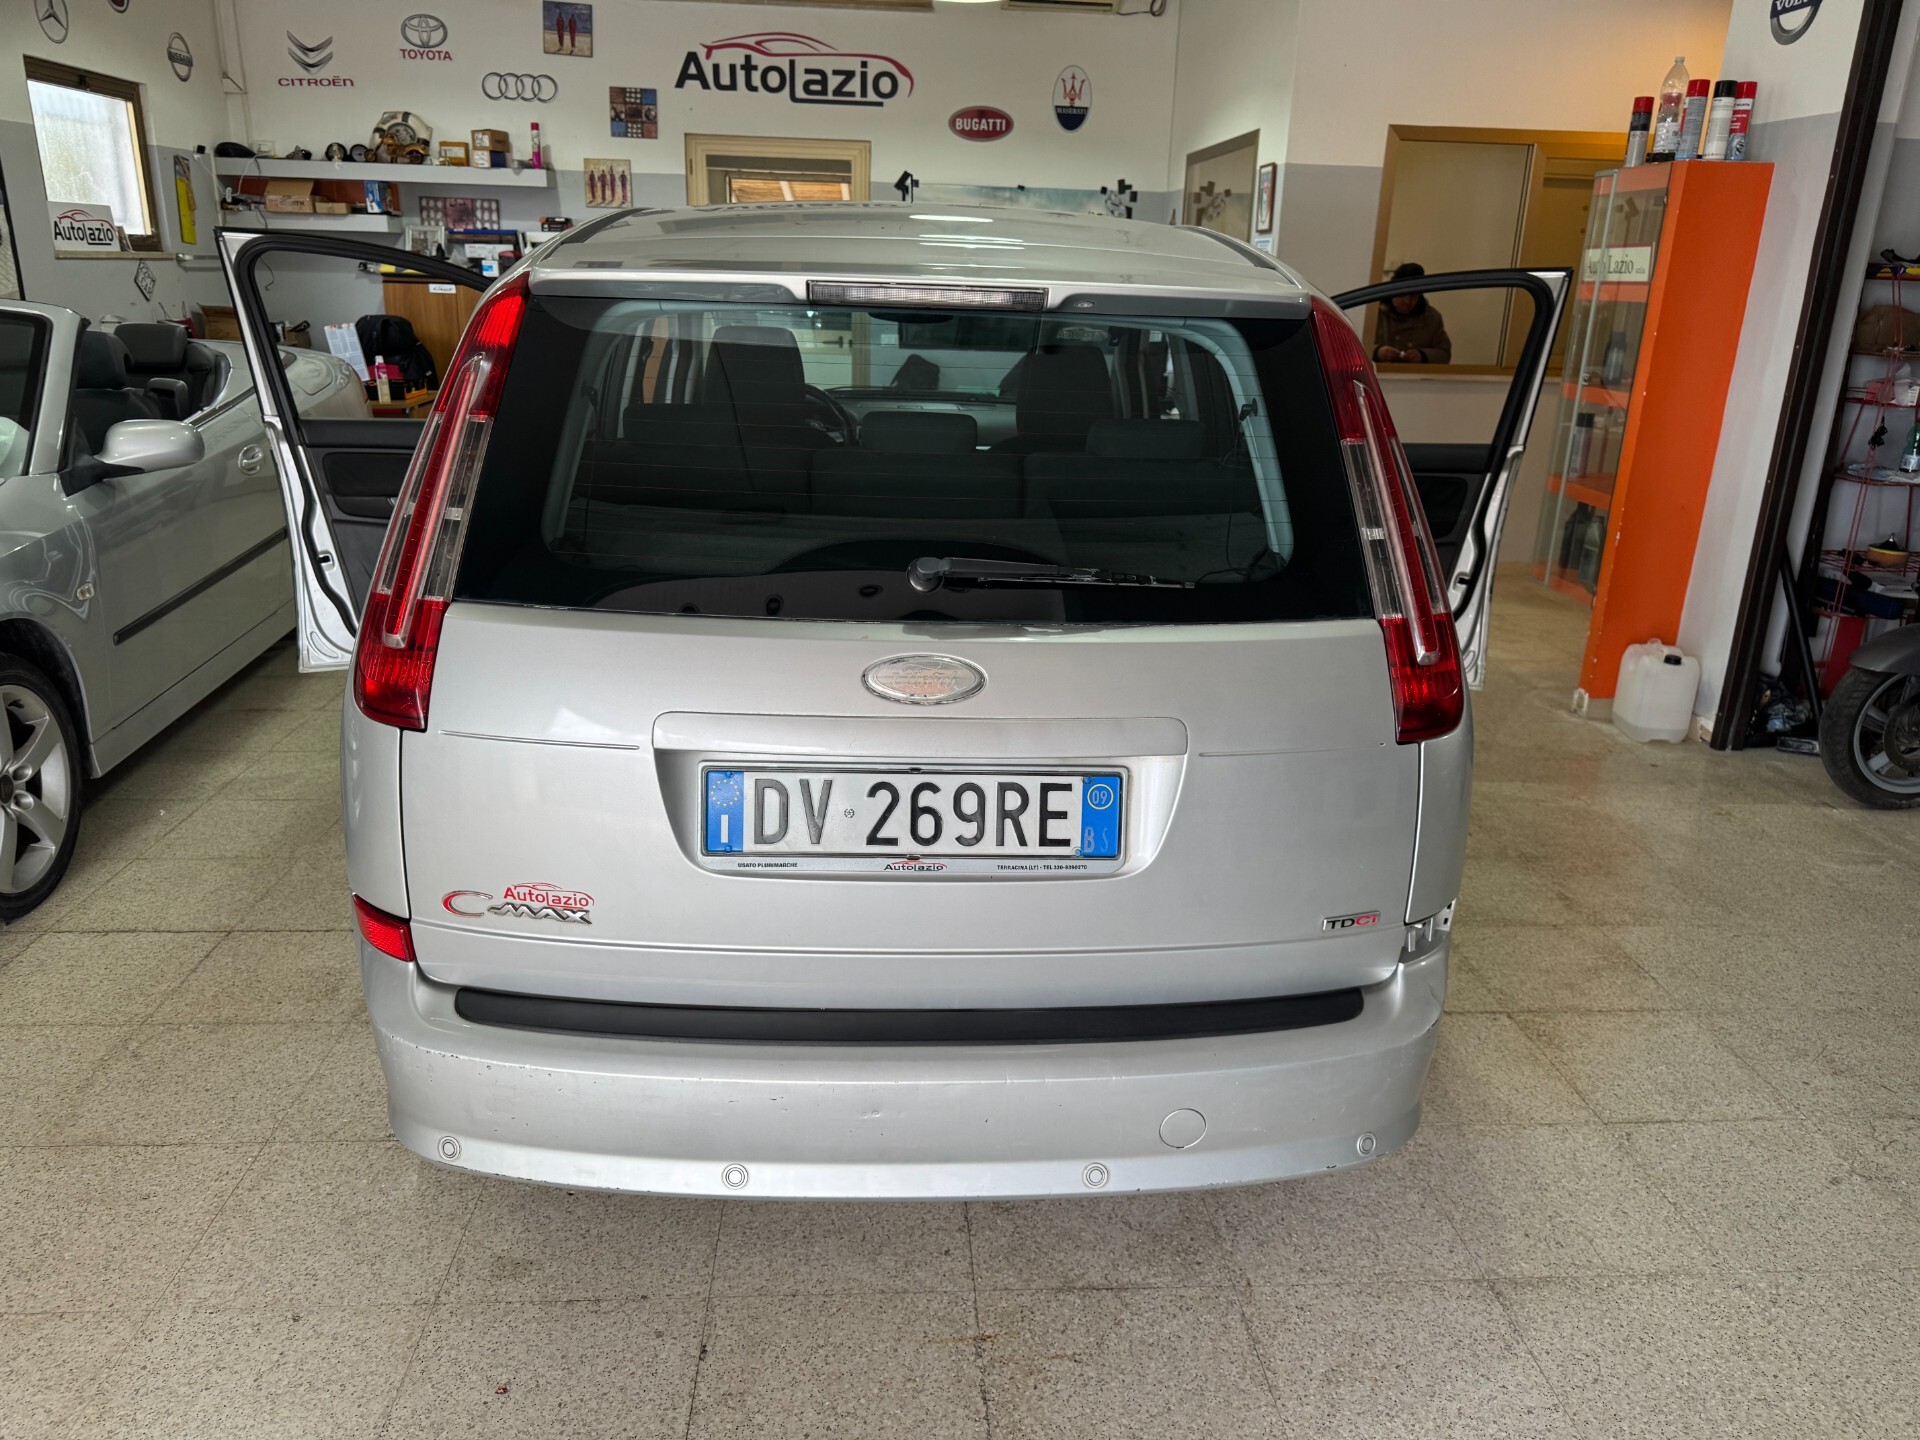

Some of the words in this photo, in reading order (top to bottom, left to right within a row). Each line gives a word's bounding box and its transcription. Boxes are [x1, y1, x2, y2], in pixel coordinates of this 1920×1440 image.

[1775, 0, 1809, 11] VOL
[400, 49, 452, 61] TOYOTA
[955, 118, 1007, 131] BUGATTI
[1607, 253, 1634, 274] Lazio
[1092, 789, 1108, 805] 09
[753, 778, 833, 845] DV
[865, 781, 1073, 848] 269RE
[720, 814, 729, 844] I
